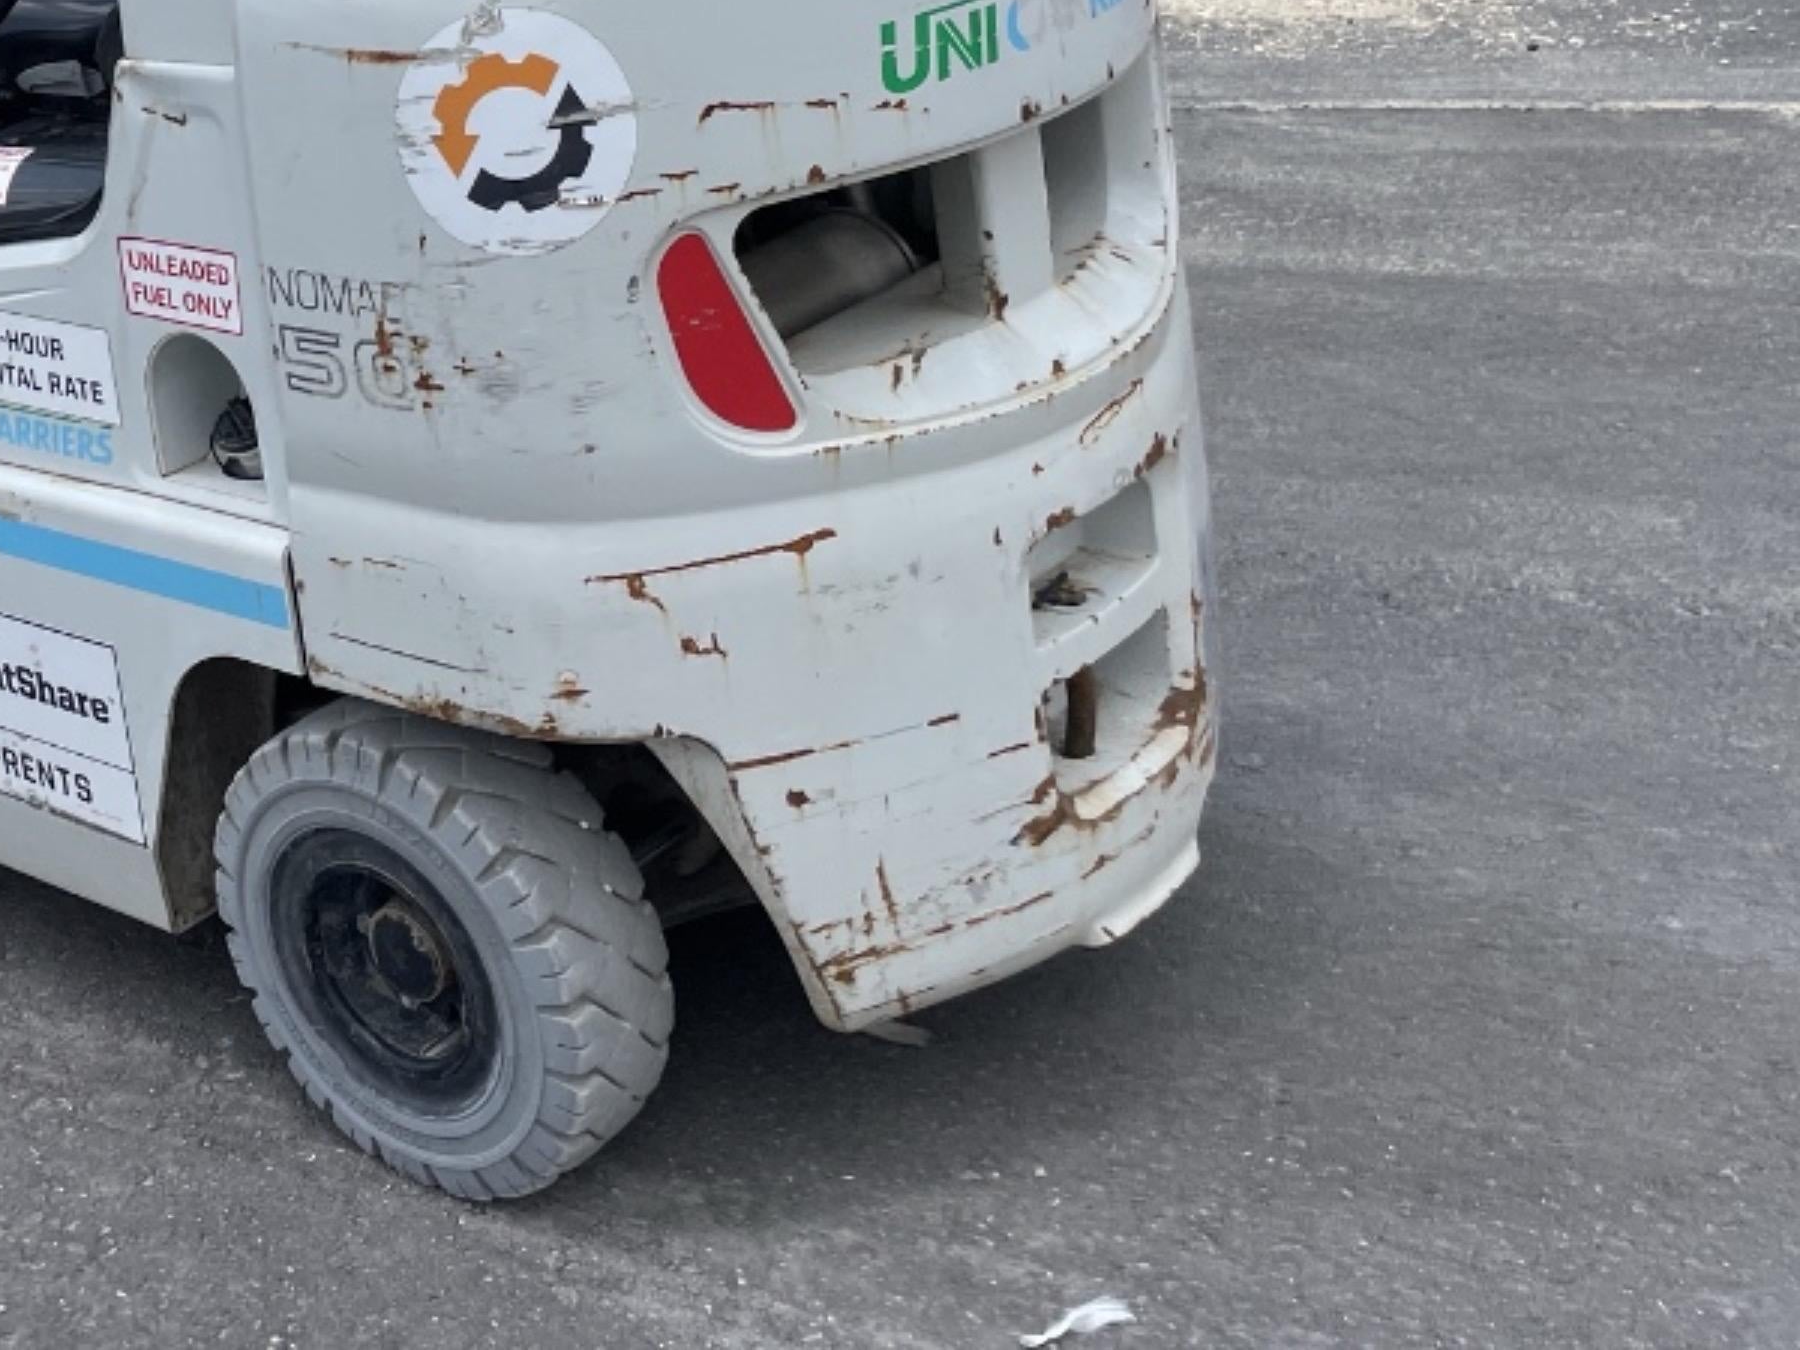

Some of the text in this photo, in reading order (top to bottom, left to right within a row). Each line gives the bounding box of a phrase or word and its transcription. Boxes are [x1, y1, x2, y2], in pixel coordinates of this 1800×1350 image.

[127, 249, 229, 287] UNLEADED
[131, 281, 233, 320] FUEL ONLY
[48, 371, 105, 406] RATE
